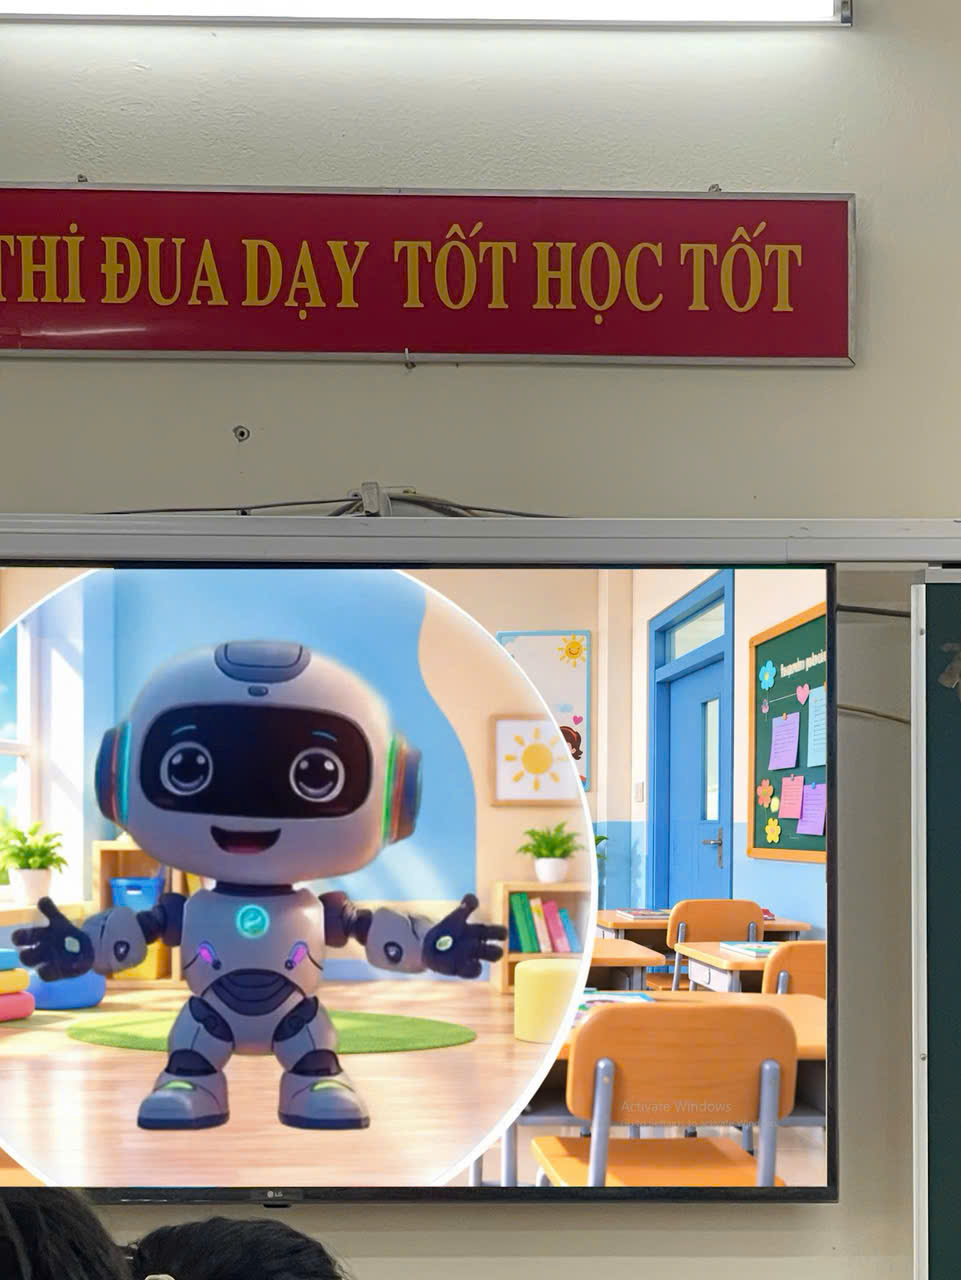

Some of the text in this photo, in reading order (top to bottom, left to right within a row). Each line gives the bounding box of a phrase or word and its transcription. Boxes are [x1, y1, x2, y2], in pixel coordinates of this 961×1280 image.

[101, 236, 229, 306] ĐUA
[242, 240, 370, 320] DẠY
[394, 221, 516, 310] TỐT
[533, 240, 663, 325] HỌC
[680, 221, 802, 313] TỐT
[621, 1101, 732, 1113] Activate Windows
